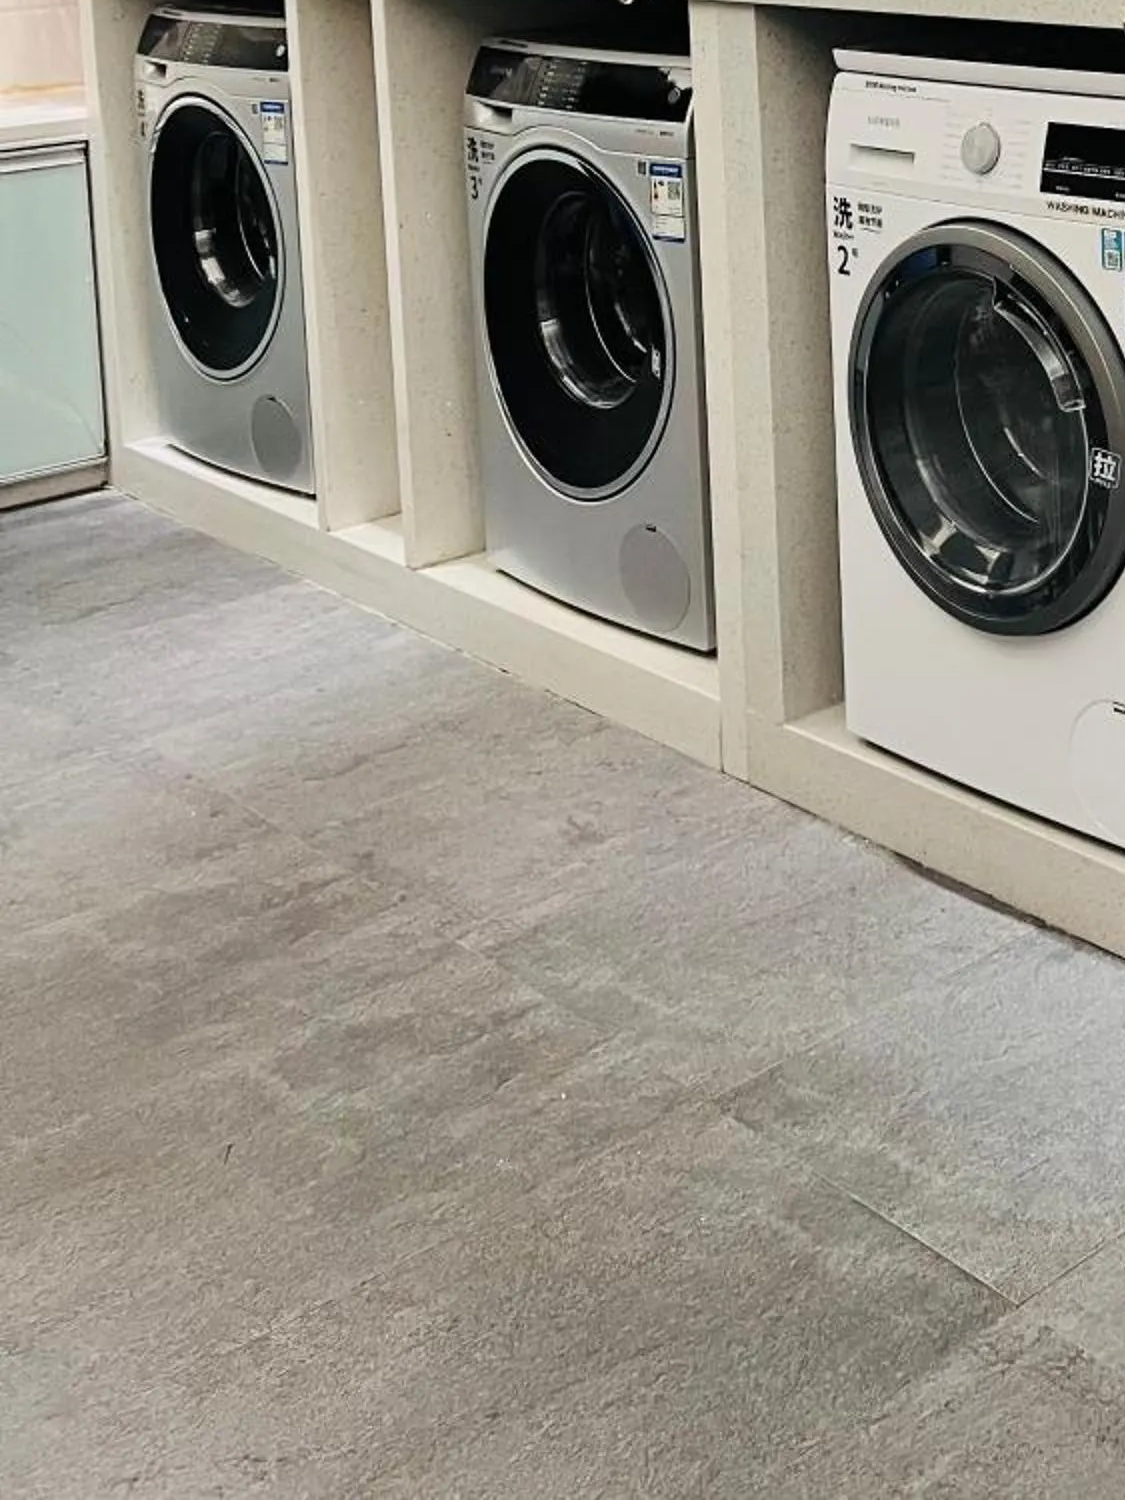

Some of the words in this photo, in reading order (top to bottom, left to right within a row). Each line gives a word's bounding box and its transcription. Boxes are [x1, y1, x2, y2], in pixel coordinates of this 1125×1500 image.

[833, 196, 853, 230] 洗
[837, 245, 851, 277] 2
[1093, 451, 1118, 482] 拉
